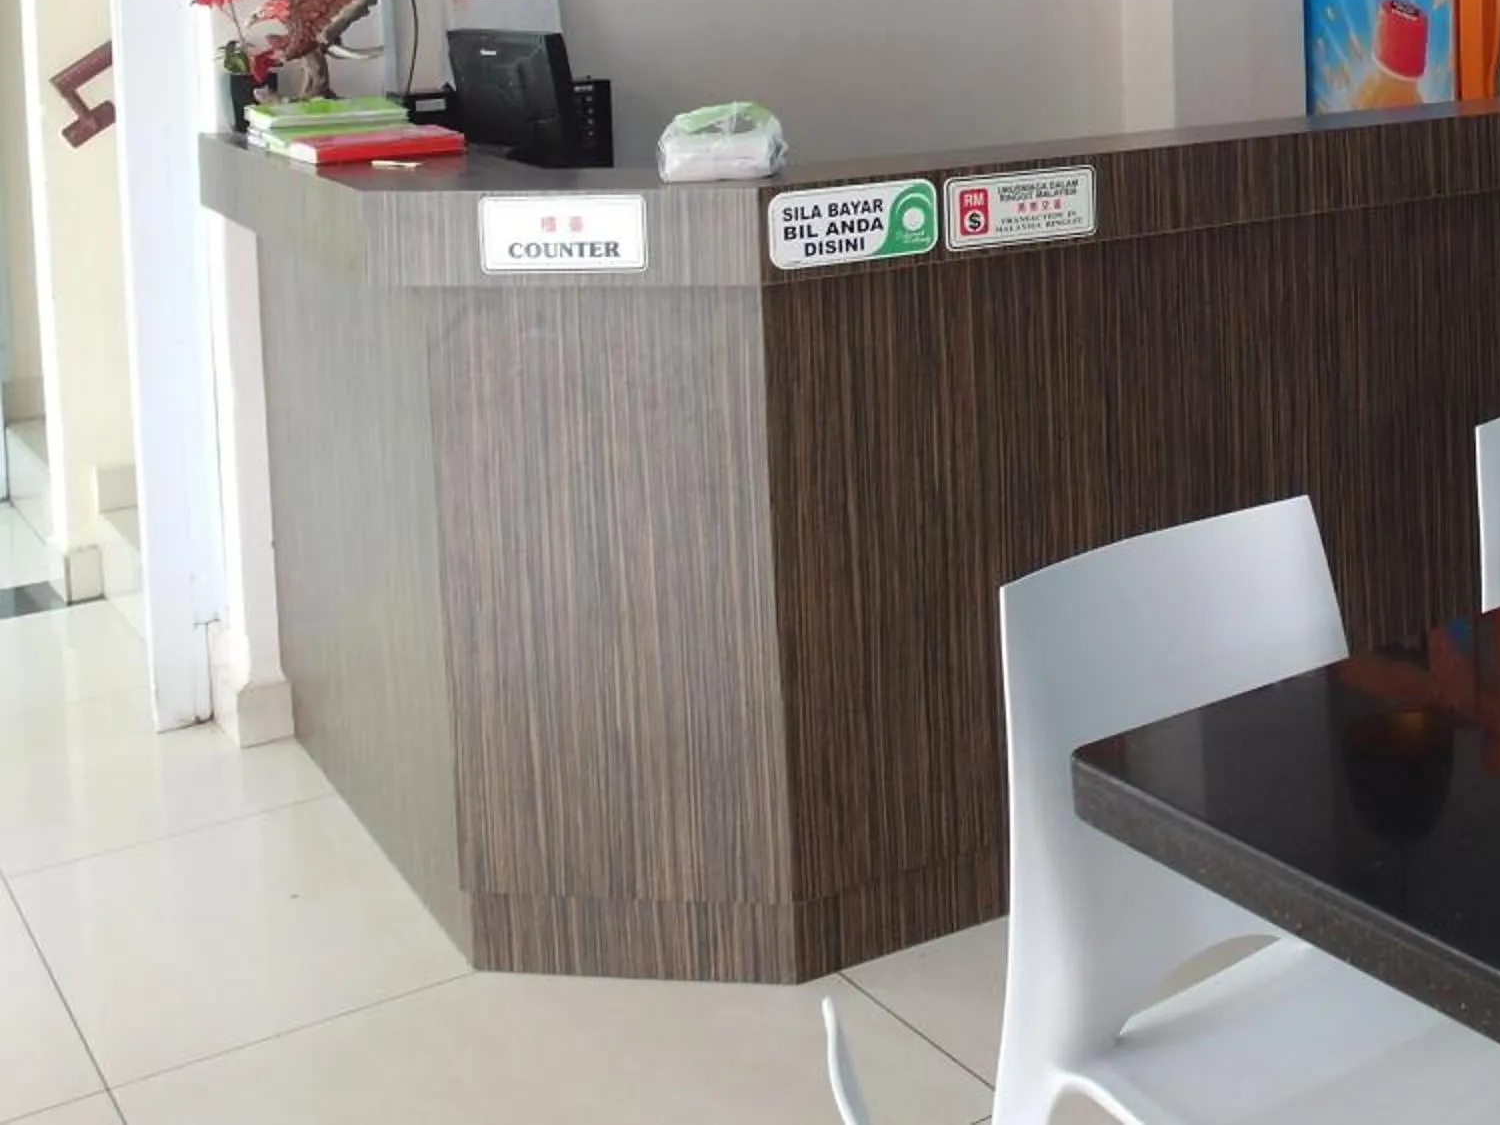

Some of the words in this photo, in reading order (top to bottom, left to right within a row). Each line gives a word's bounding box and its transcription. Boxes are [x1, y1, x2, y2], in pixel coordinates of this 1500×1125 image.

[962, 192, 985, 207] RM
[783, 204, 822, 222] SILA
[828, 198, 884, 218] BAYAR
[783, 225, 818, 241] BIL
[826, 217, 884, 236] ANDA
[508, 241, 621, 259] COUNTER
[804, 237, 865, 257] DISINI
